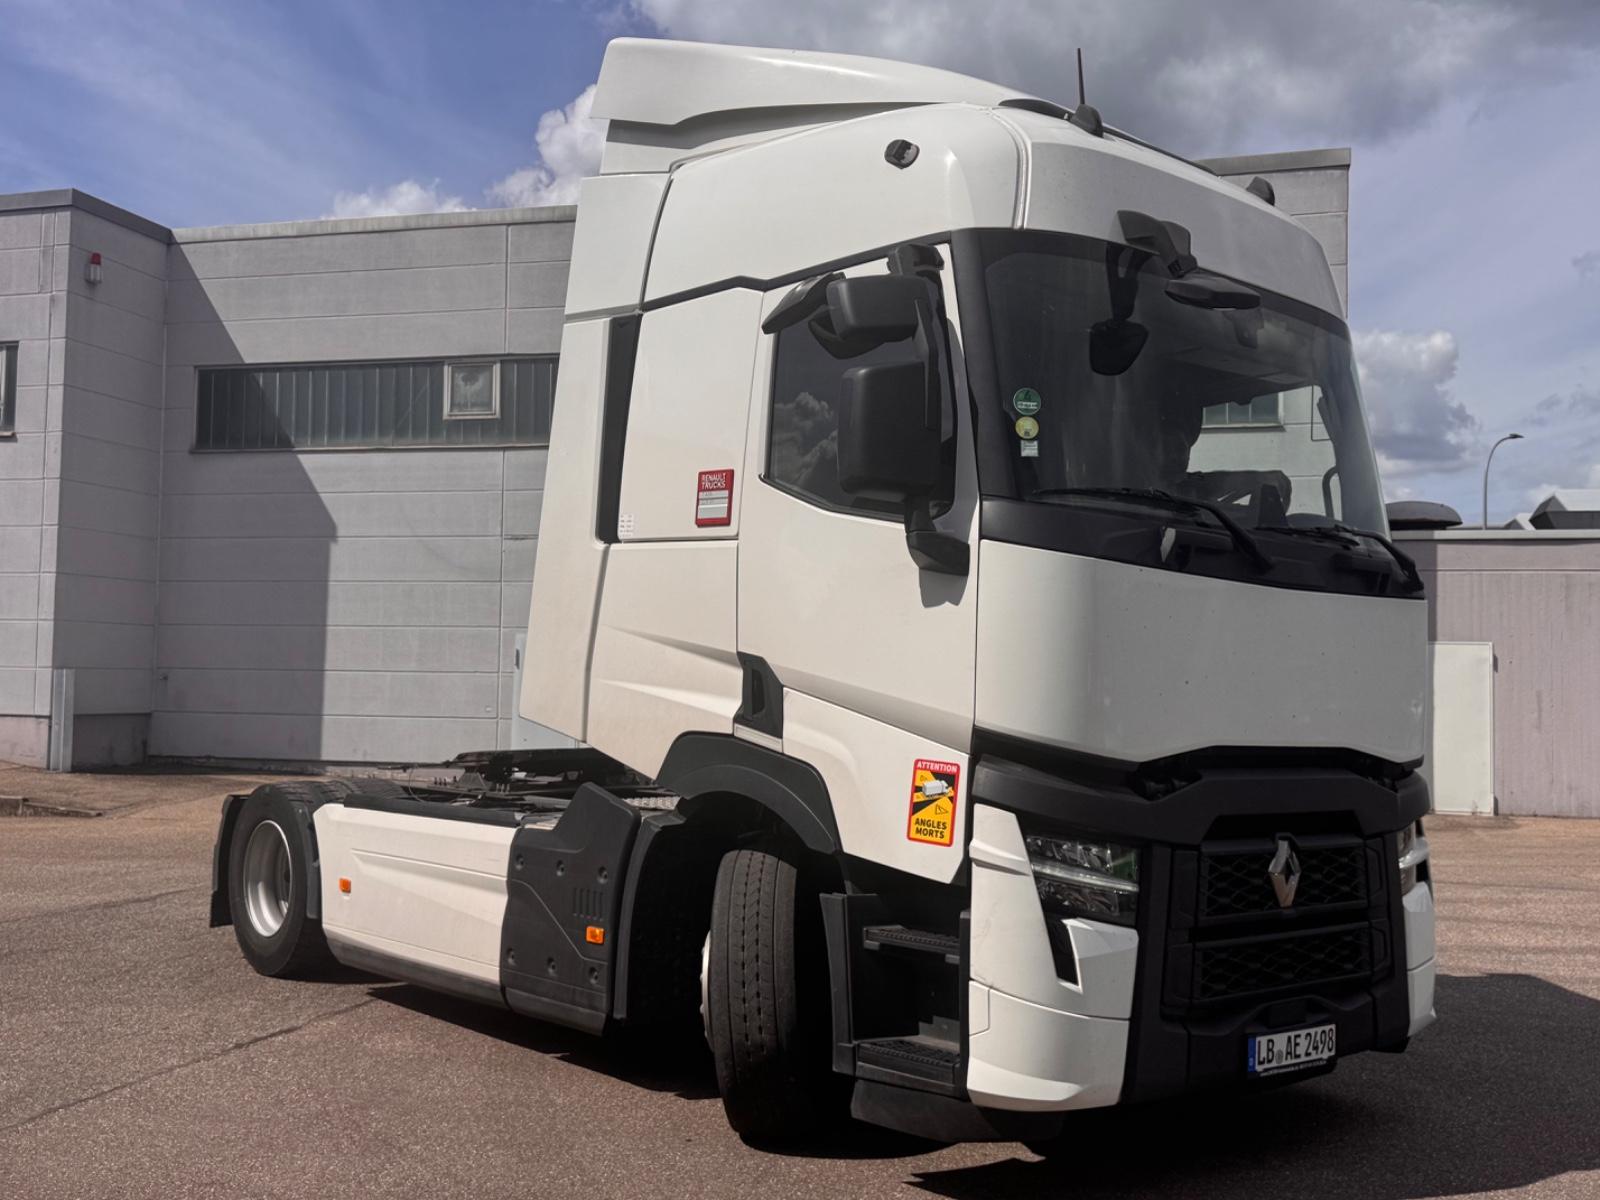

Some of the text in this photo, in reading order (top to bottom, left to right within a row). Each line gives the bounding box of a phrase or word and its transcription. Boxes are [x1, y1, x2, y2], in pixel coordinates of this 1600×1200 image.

[701, 473, 726, 482] RENAULT
[702, 481, 726, 490] TRUCKS
[917, 761, 958, 773] ATTENTION
[915, 817, 947, 829] ANGLES
[915, 827, 945, 839] MORTS
[1257, 1027, 1334, 1066] LB AE 2498
